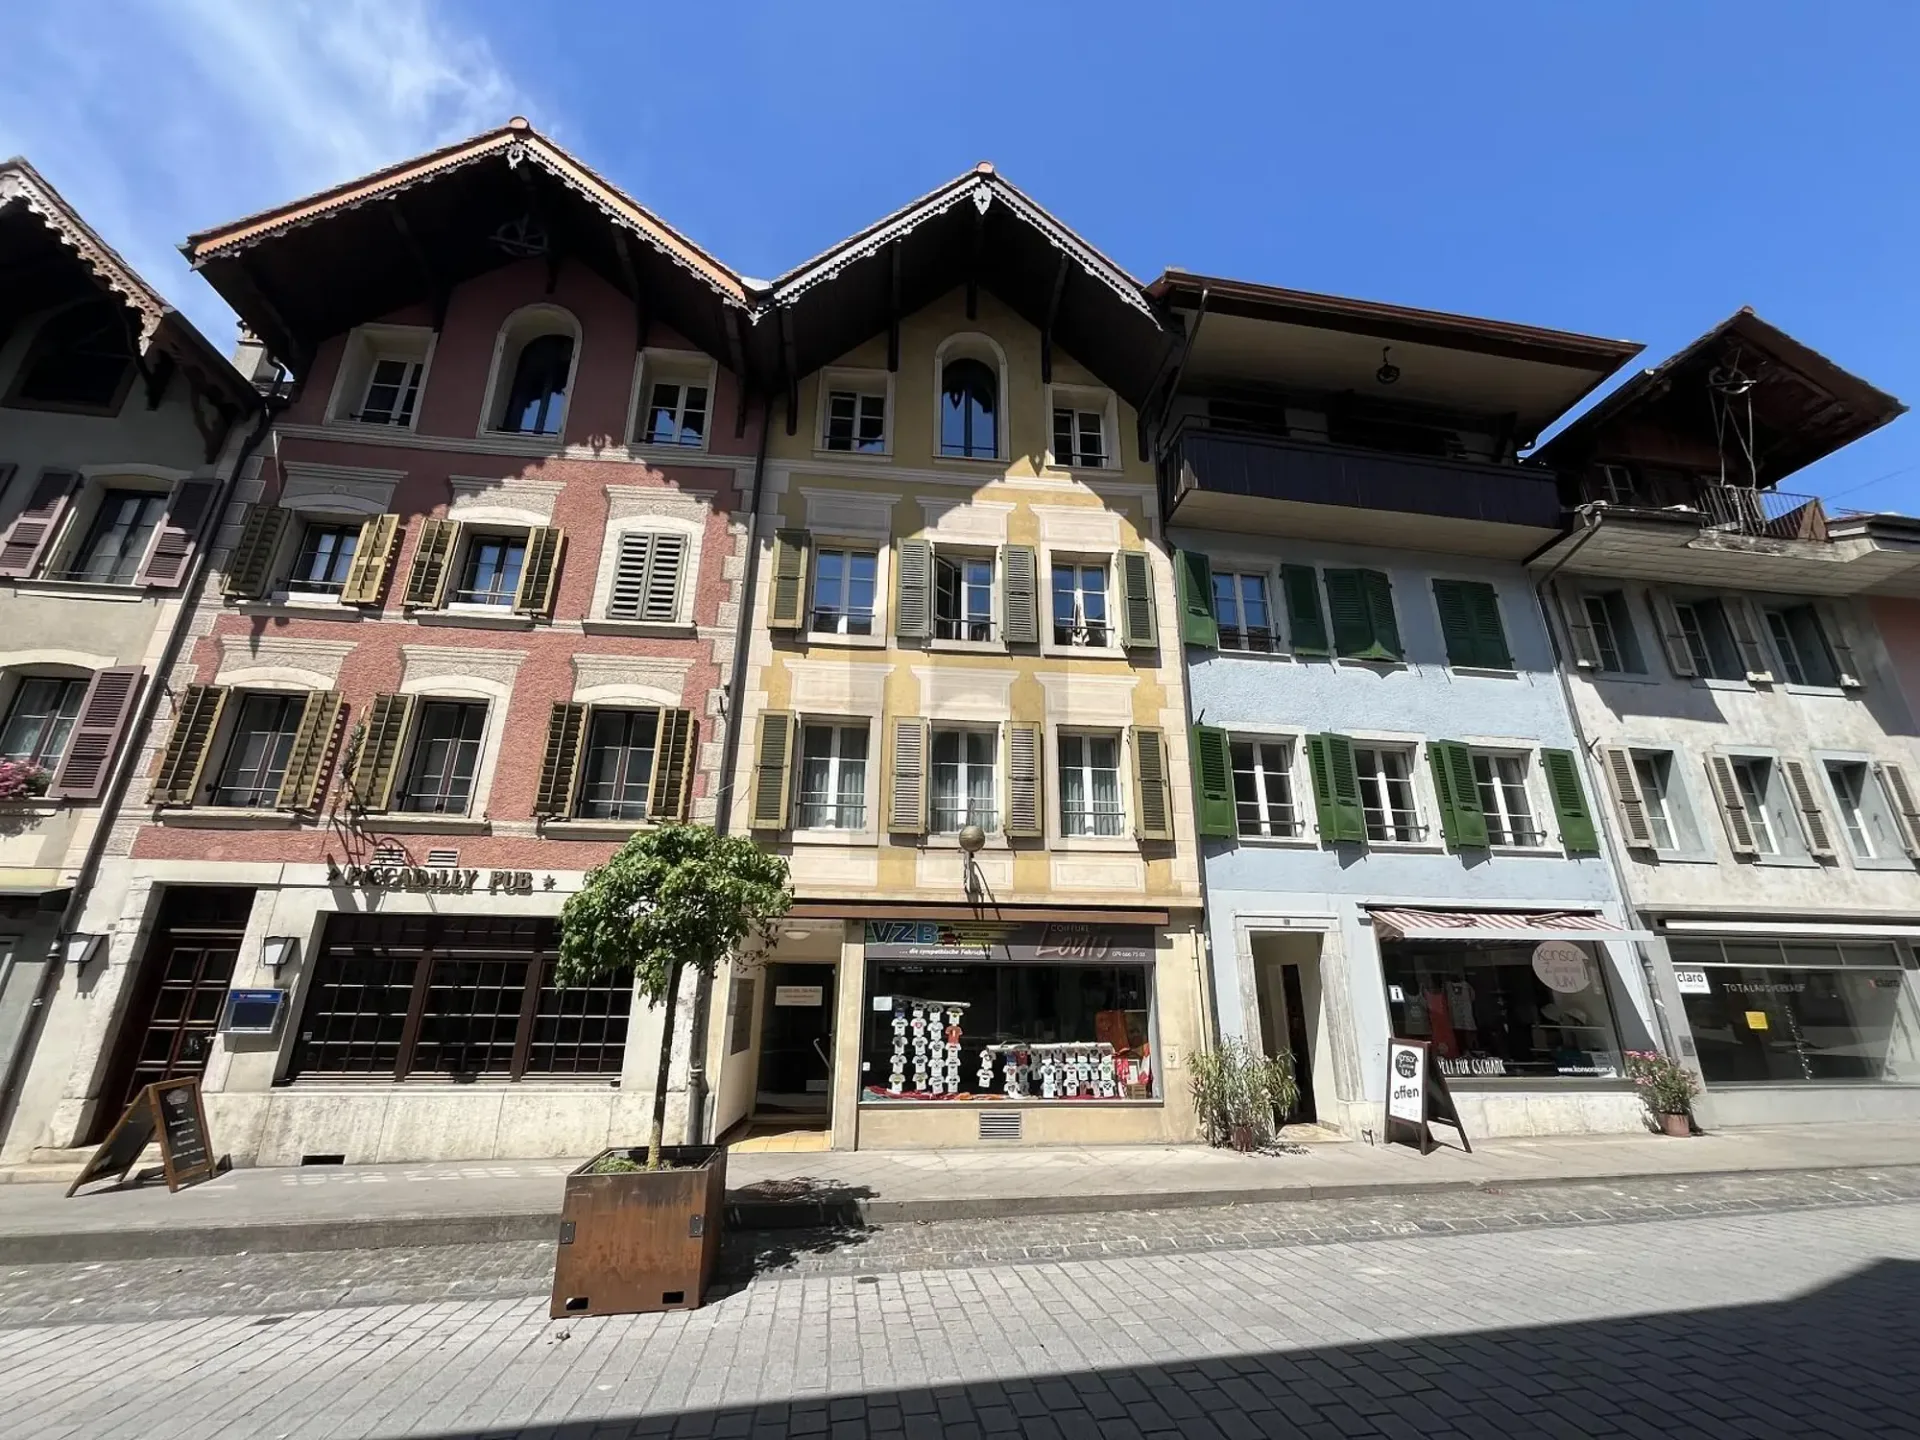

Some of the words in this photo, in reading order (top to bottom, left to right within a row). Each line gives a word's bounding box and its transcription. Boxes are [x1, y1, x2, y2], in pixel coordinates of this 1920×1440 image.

[488, 869, 534, 890] PUB
[870, 921, 939, 944] VZB
[1677, 971, 1704, 983] claro
[1394, 1085, 1420, 1100] offen
